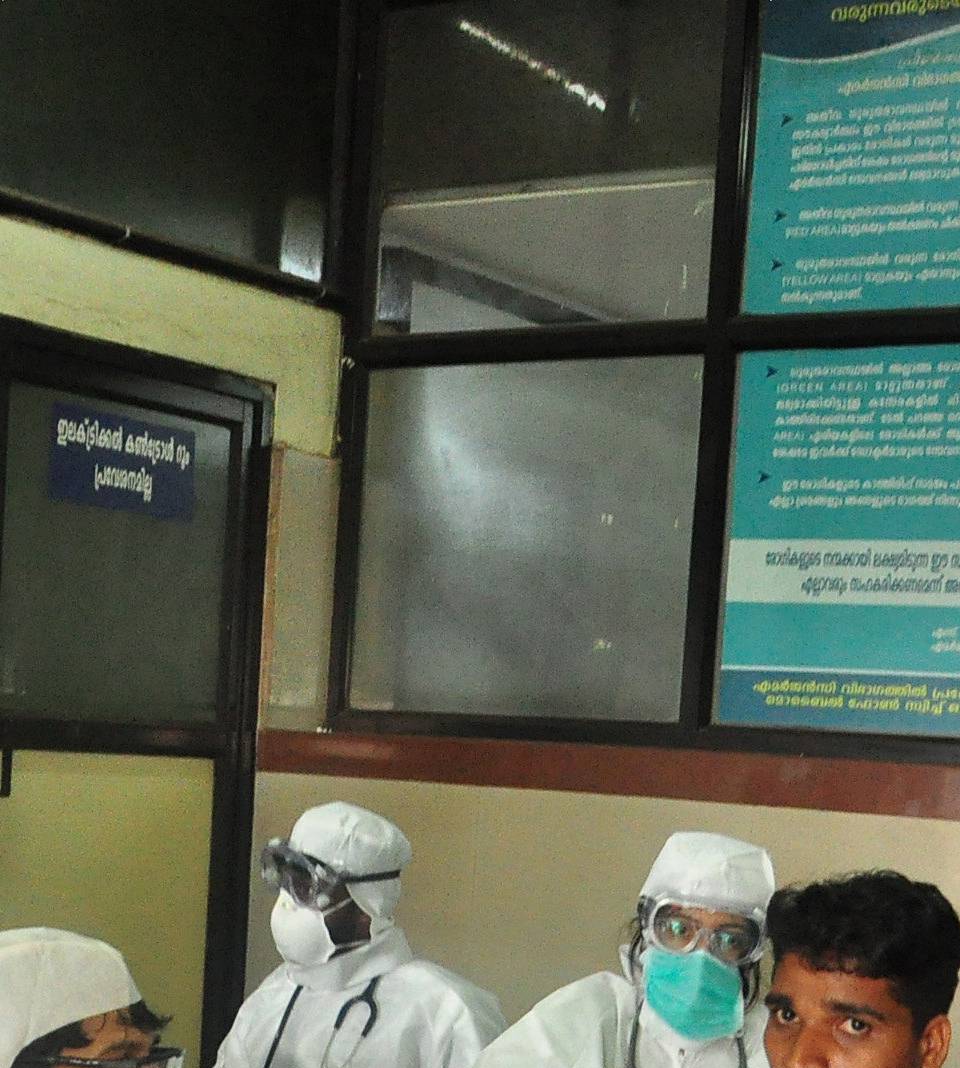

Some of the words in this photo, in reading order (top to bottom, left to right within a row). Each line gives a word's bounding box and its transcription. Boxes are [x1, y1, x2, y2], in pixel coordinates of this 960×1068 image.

[57, 417, 123, 452] ഇലക്ട്രിക്കൽ
[176, 443, 191, 471] റൂം
[94, 462, 153, 503] പ്രവേശനമില്ല
